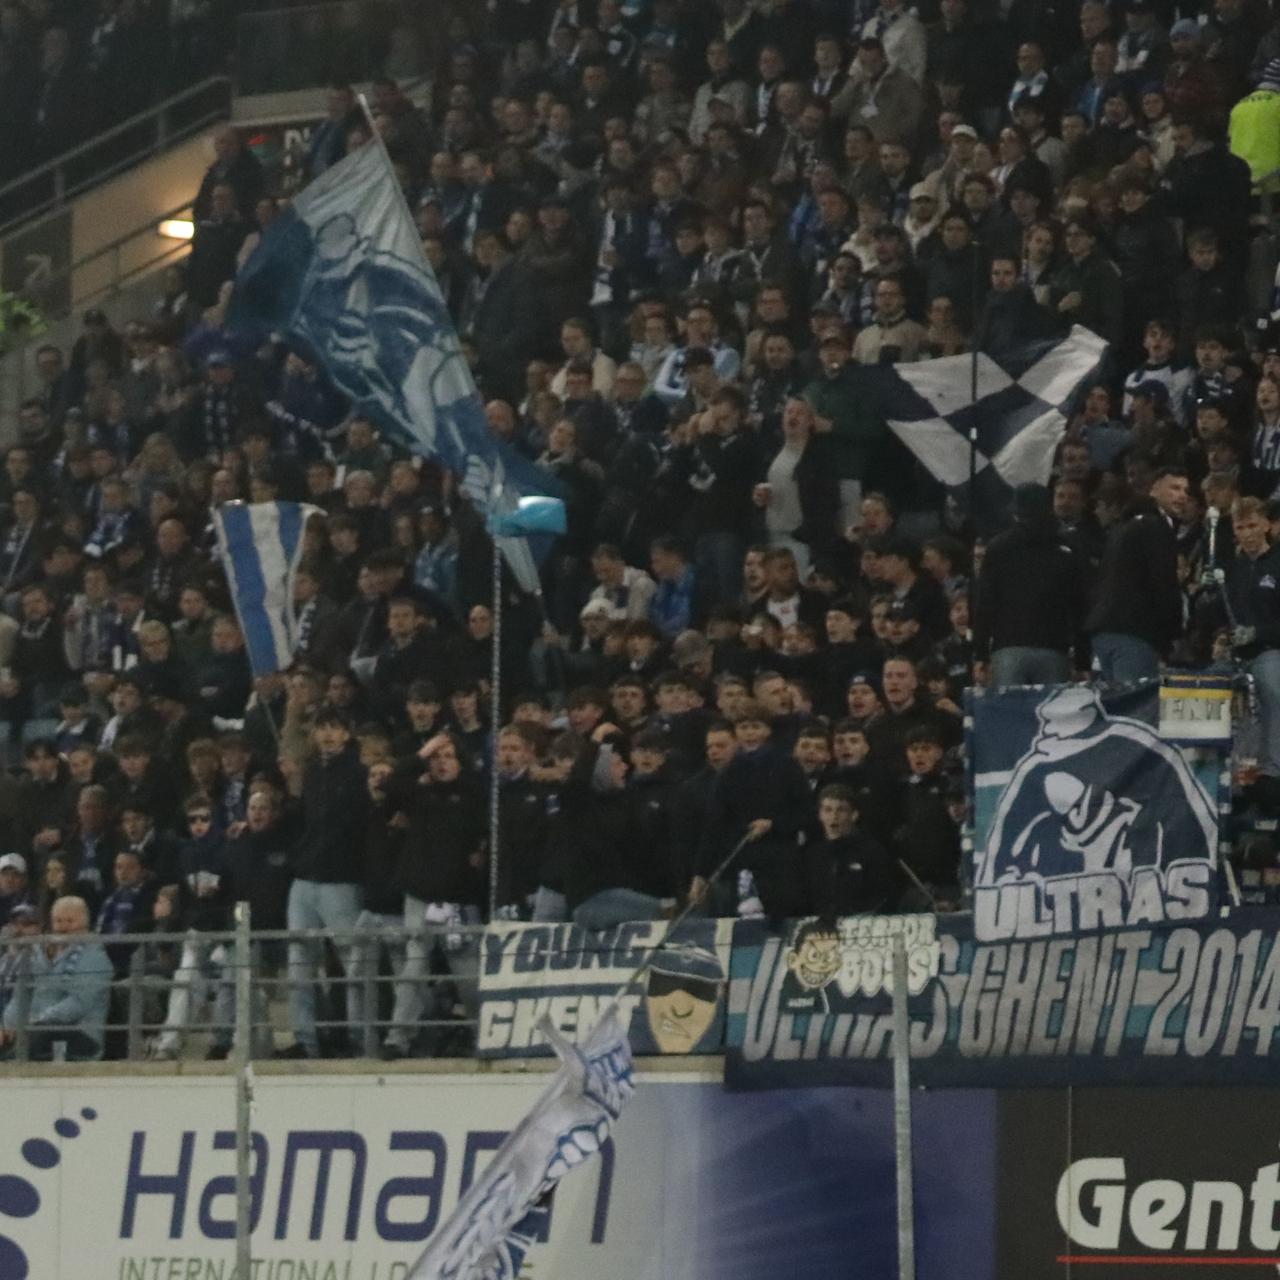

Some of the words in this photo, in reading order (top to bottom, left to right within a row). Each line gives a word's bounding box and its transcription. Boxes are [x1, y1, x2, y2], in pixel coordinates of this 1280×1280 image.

[974, 860, 1211, 942] ULTRAS
[485, 921, 653, 976] YOUNG
[840, 949, 930, 997] BOS
[959, 931, 1151, 1057] GHENT
[1144, 927, 1280, 1057] 2014
